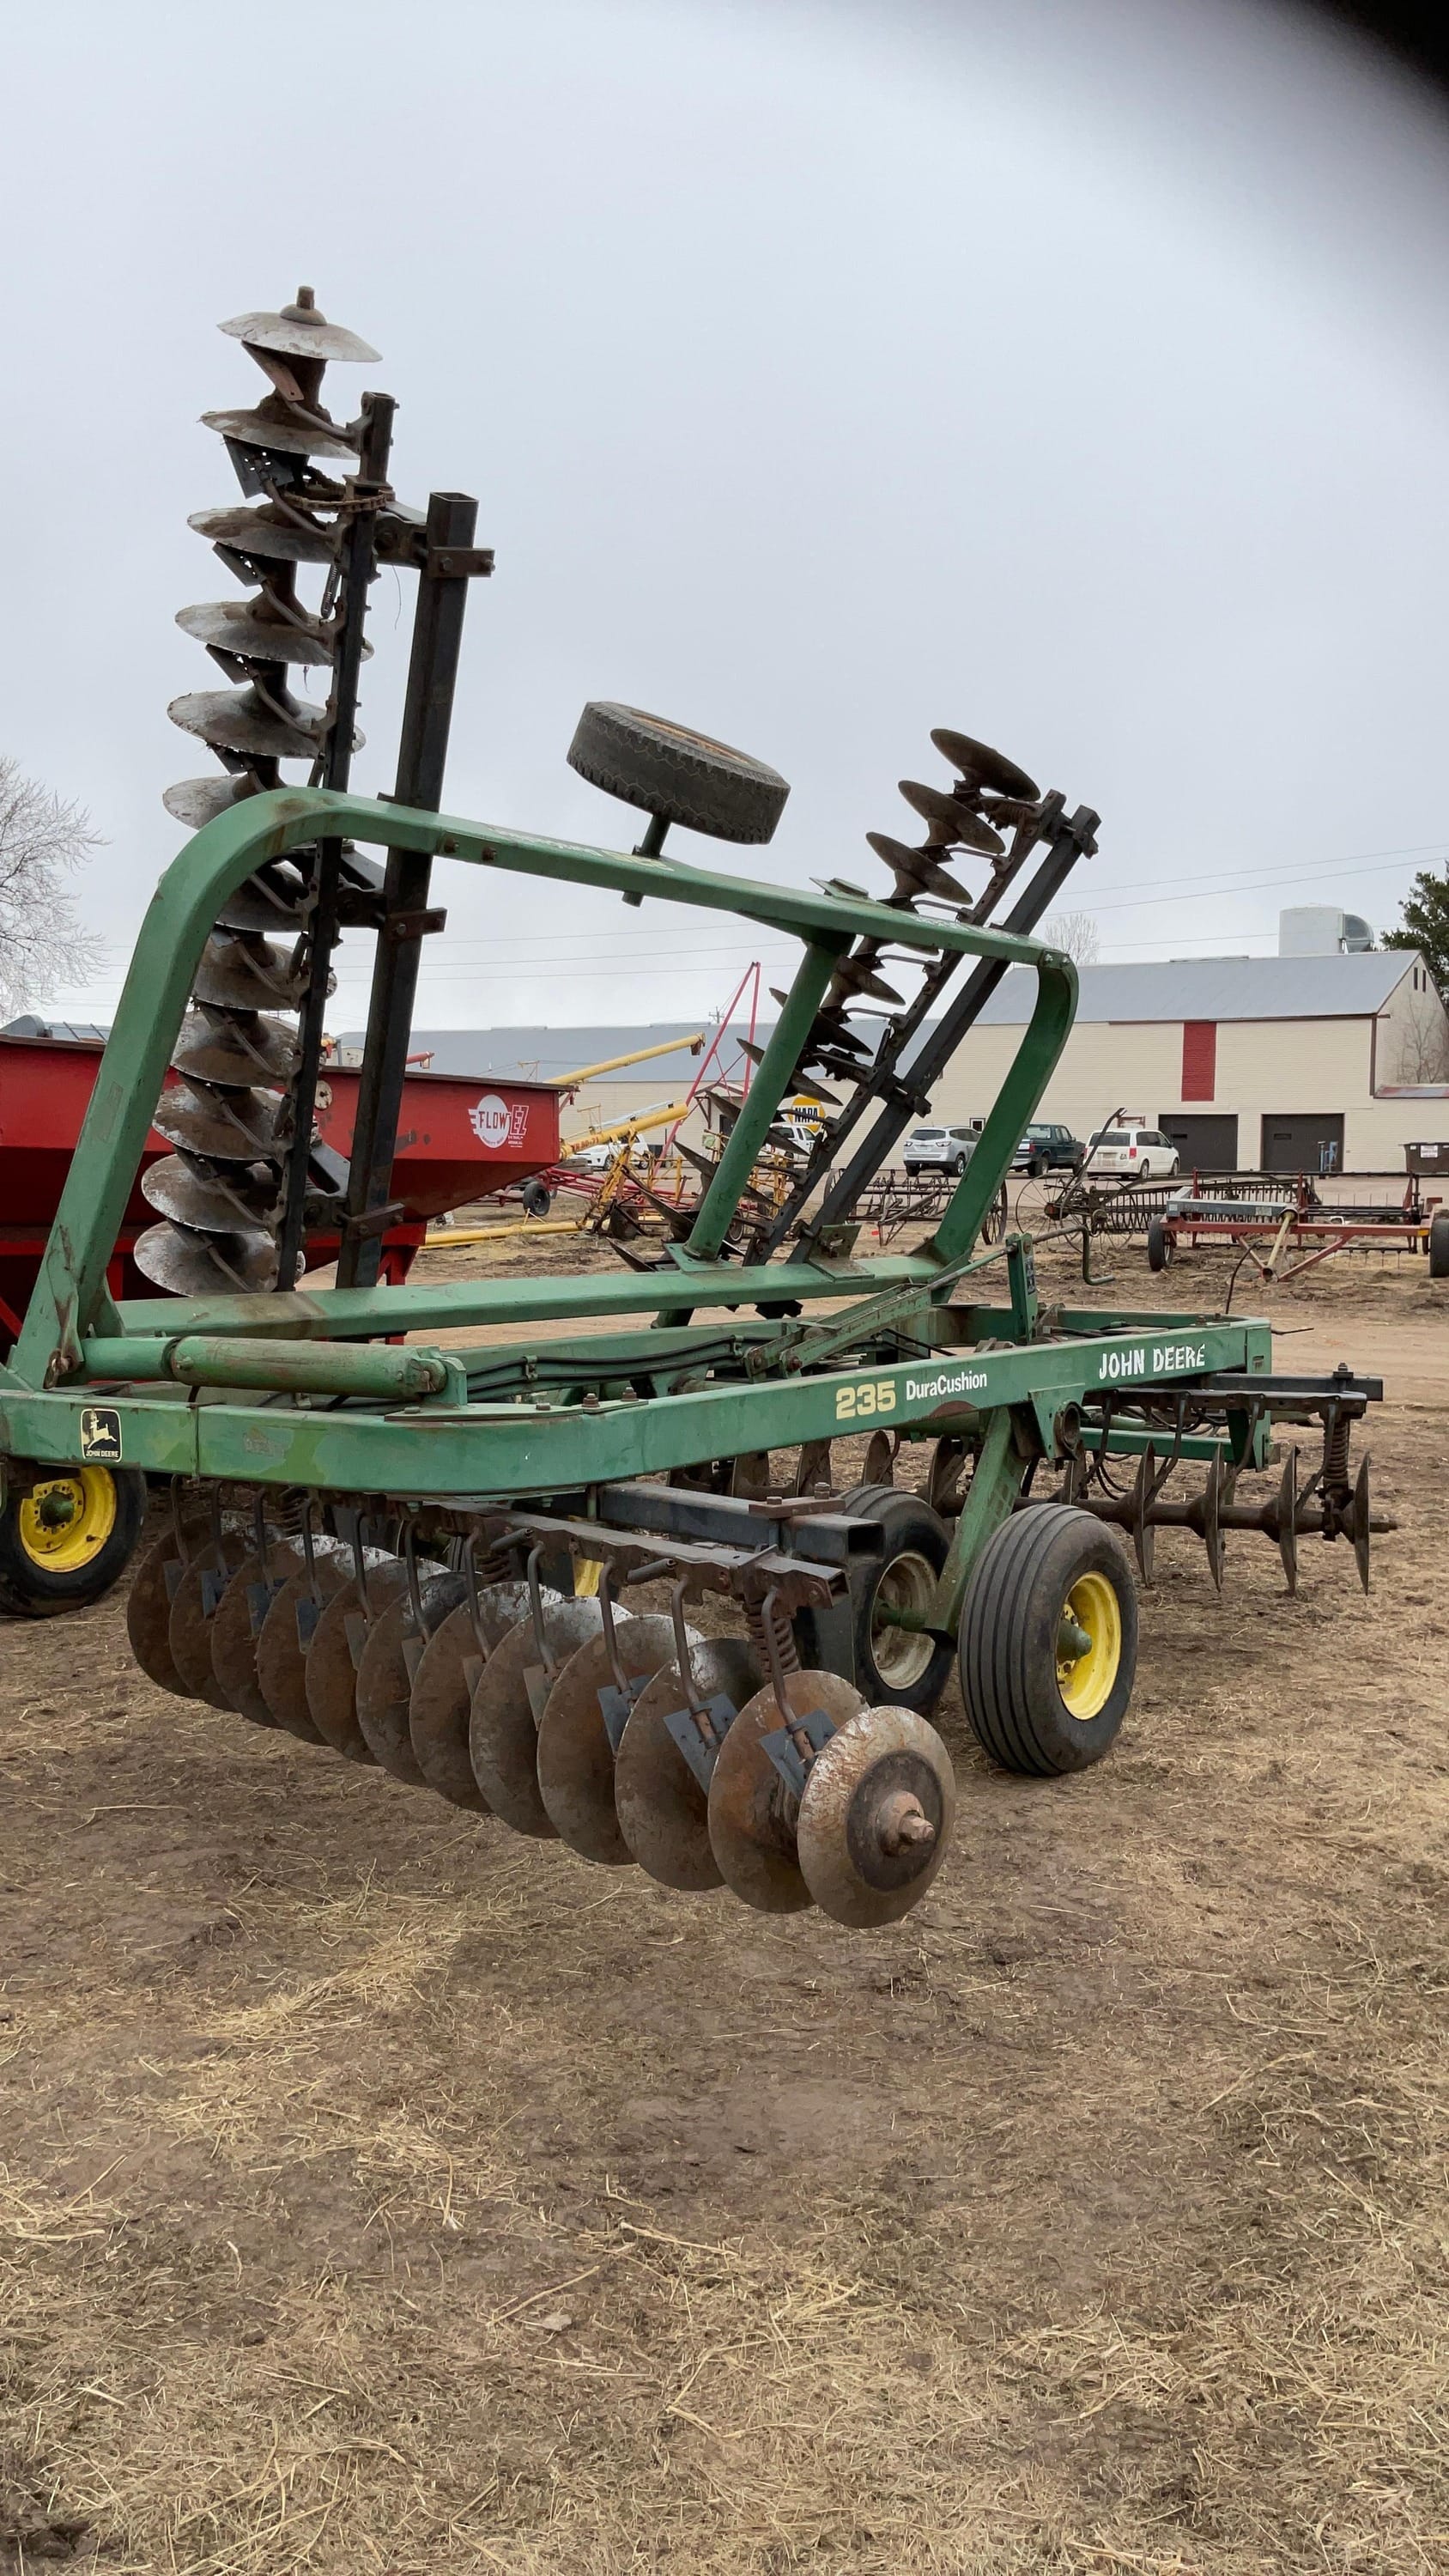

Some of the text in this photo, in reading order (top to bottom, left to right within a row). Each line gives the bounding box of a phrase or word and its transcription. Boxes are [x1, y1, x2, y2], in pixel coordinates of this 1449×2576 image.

[478, 1104, 530, 1136] FLOW EZ
[1099, 1343, 1206, 1380] JOHN DEERE
[836, 1380, 896, 1420] 235
[906, 1370, 987, 1401] DuraCushion
